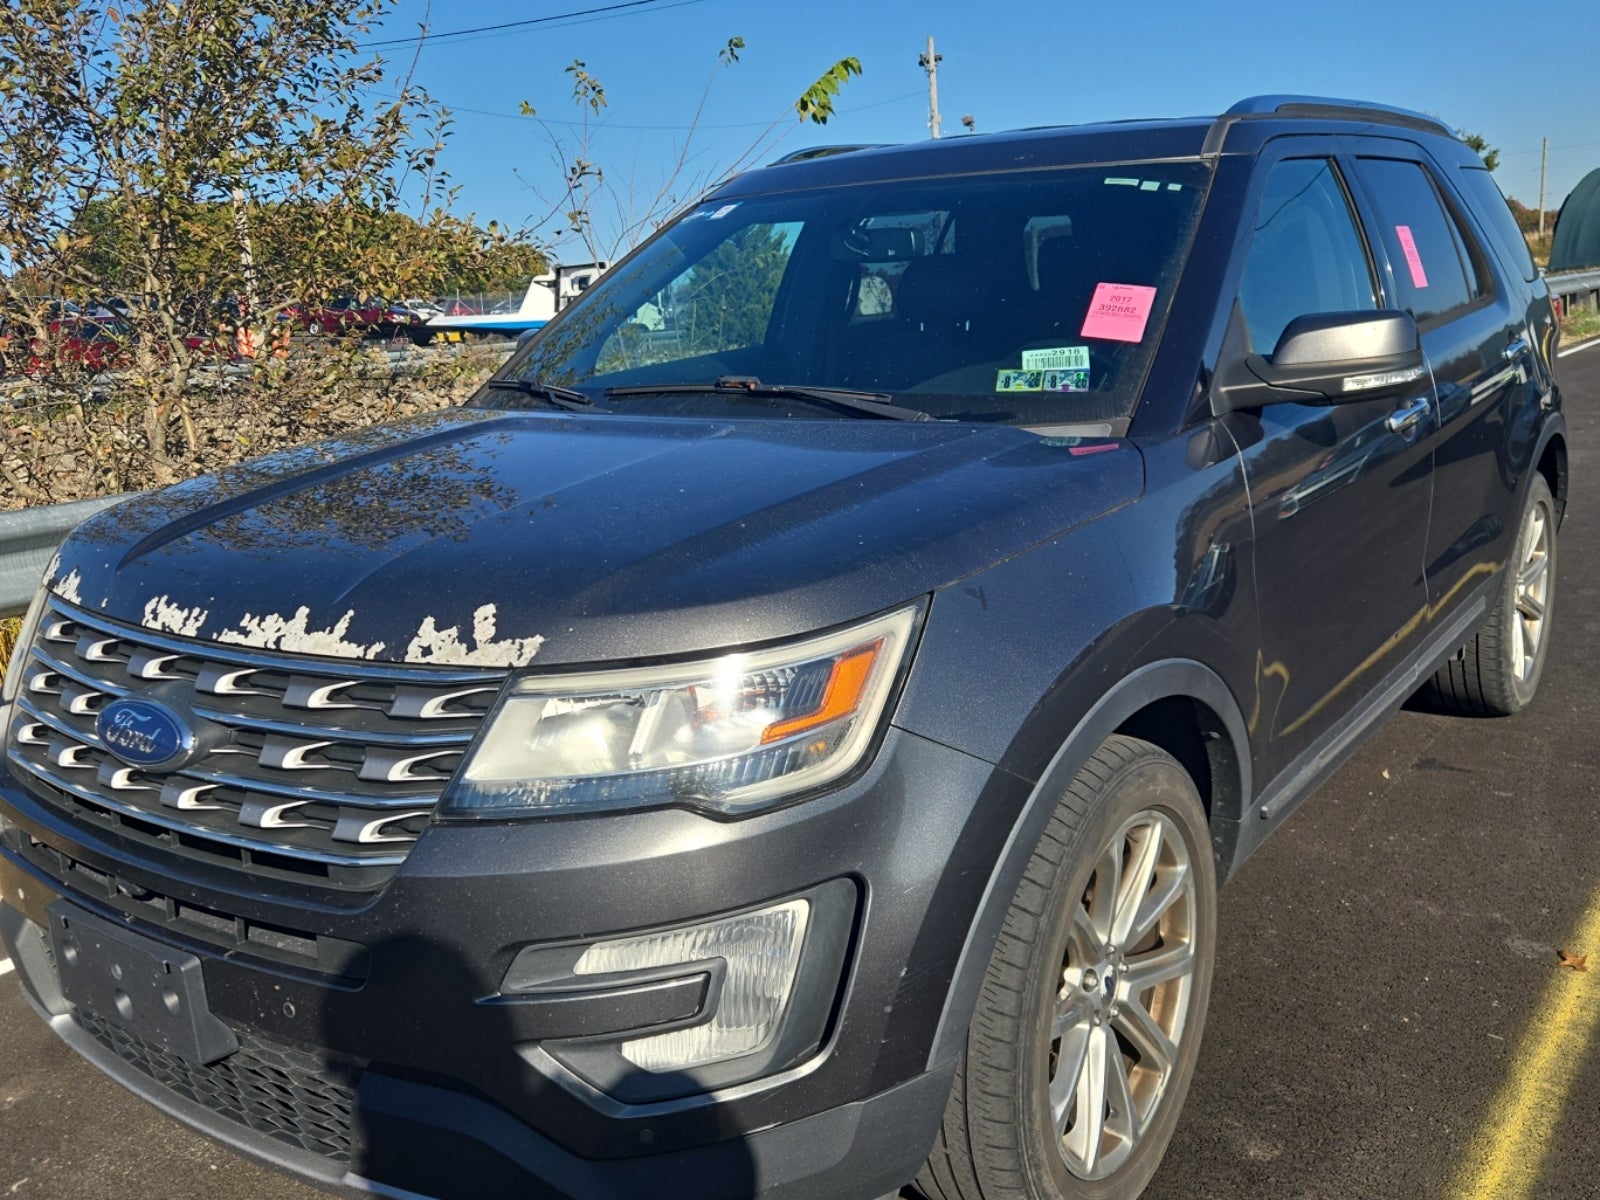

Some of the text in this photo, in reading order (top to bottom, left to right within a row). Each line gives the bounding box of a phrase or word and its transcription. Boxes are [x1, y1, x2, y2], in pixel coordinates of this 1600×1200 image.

[1109, 295, 1133, 303] 2017
[1098, 304, 1137, 313] 392882
[105, 708, 162, 753] Ford
